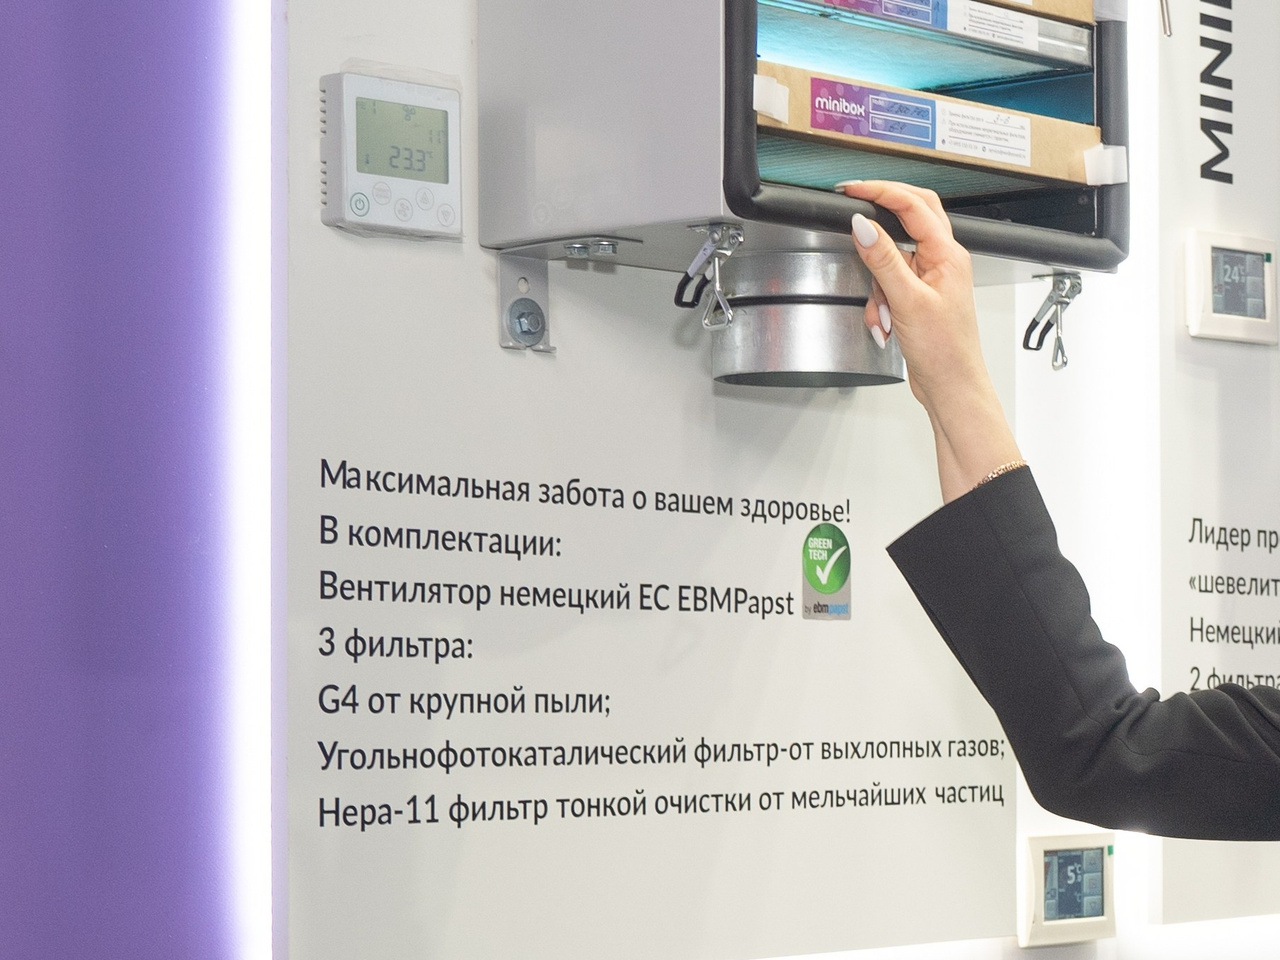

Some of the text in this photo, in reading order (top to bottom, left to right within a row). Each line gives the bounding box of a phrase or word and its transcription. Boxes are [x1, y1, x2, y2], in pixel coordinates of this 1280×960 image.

[815, 96, 865, 116] minibox
[1199, 0, 1232, 184] MINI
[321, 458, 850, 525] Максимальная забота о вашем здоровье!
[320, 514, 561, 561] В комплектации:
[808, 537, 832, 549] GREEN
[1188, 517, 1251, 551] Лидер
[808, 549, 828, 560] TECH
[319, 569, 491, 611] Вентилятор
[500, 582, 630, 614] немецкий
[678, 584, 794, 620] EBMPapst
[318, 626, 474, 665] 3 фильтра:
[1190, 666, 1200, 692] 2
[318, 684, 612, 720] G4 от крупной пыли;
[317, 736, 1006, 774] Угольнофотокаталический фильтр-от выхлопных газов;
[448, 794, 549, 829] фильтр
[556, 789, 647, 818] тонкой
[654, 792, 752, 815] очистки
[758, 789, 785, 810] от
[791, 782, 927, 809] мельчайших
[934, 784, 1005, 806] частиц
